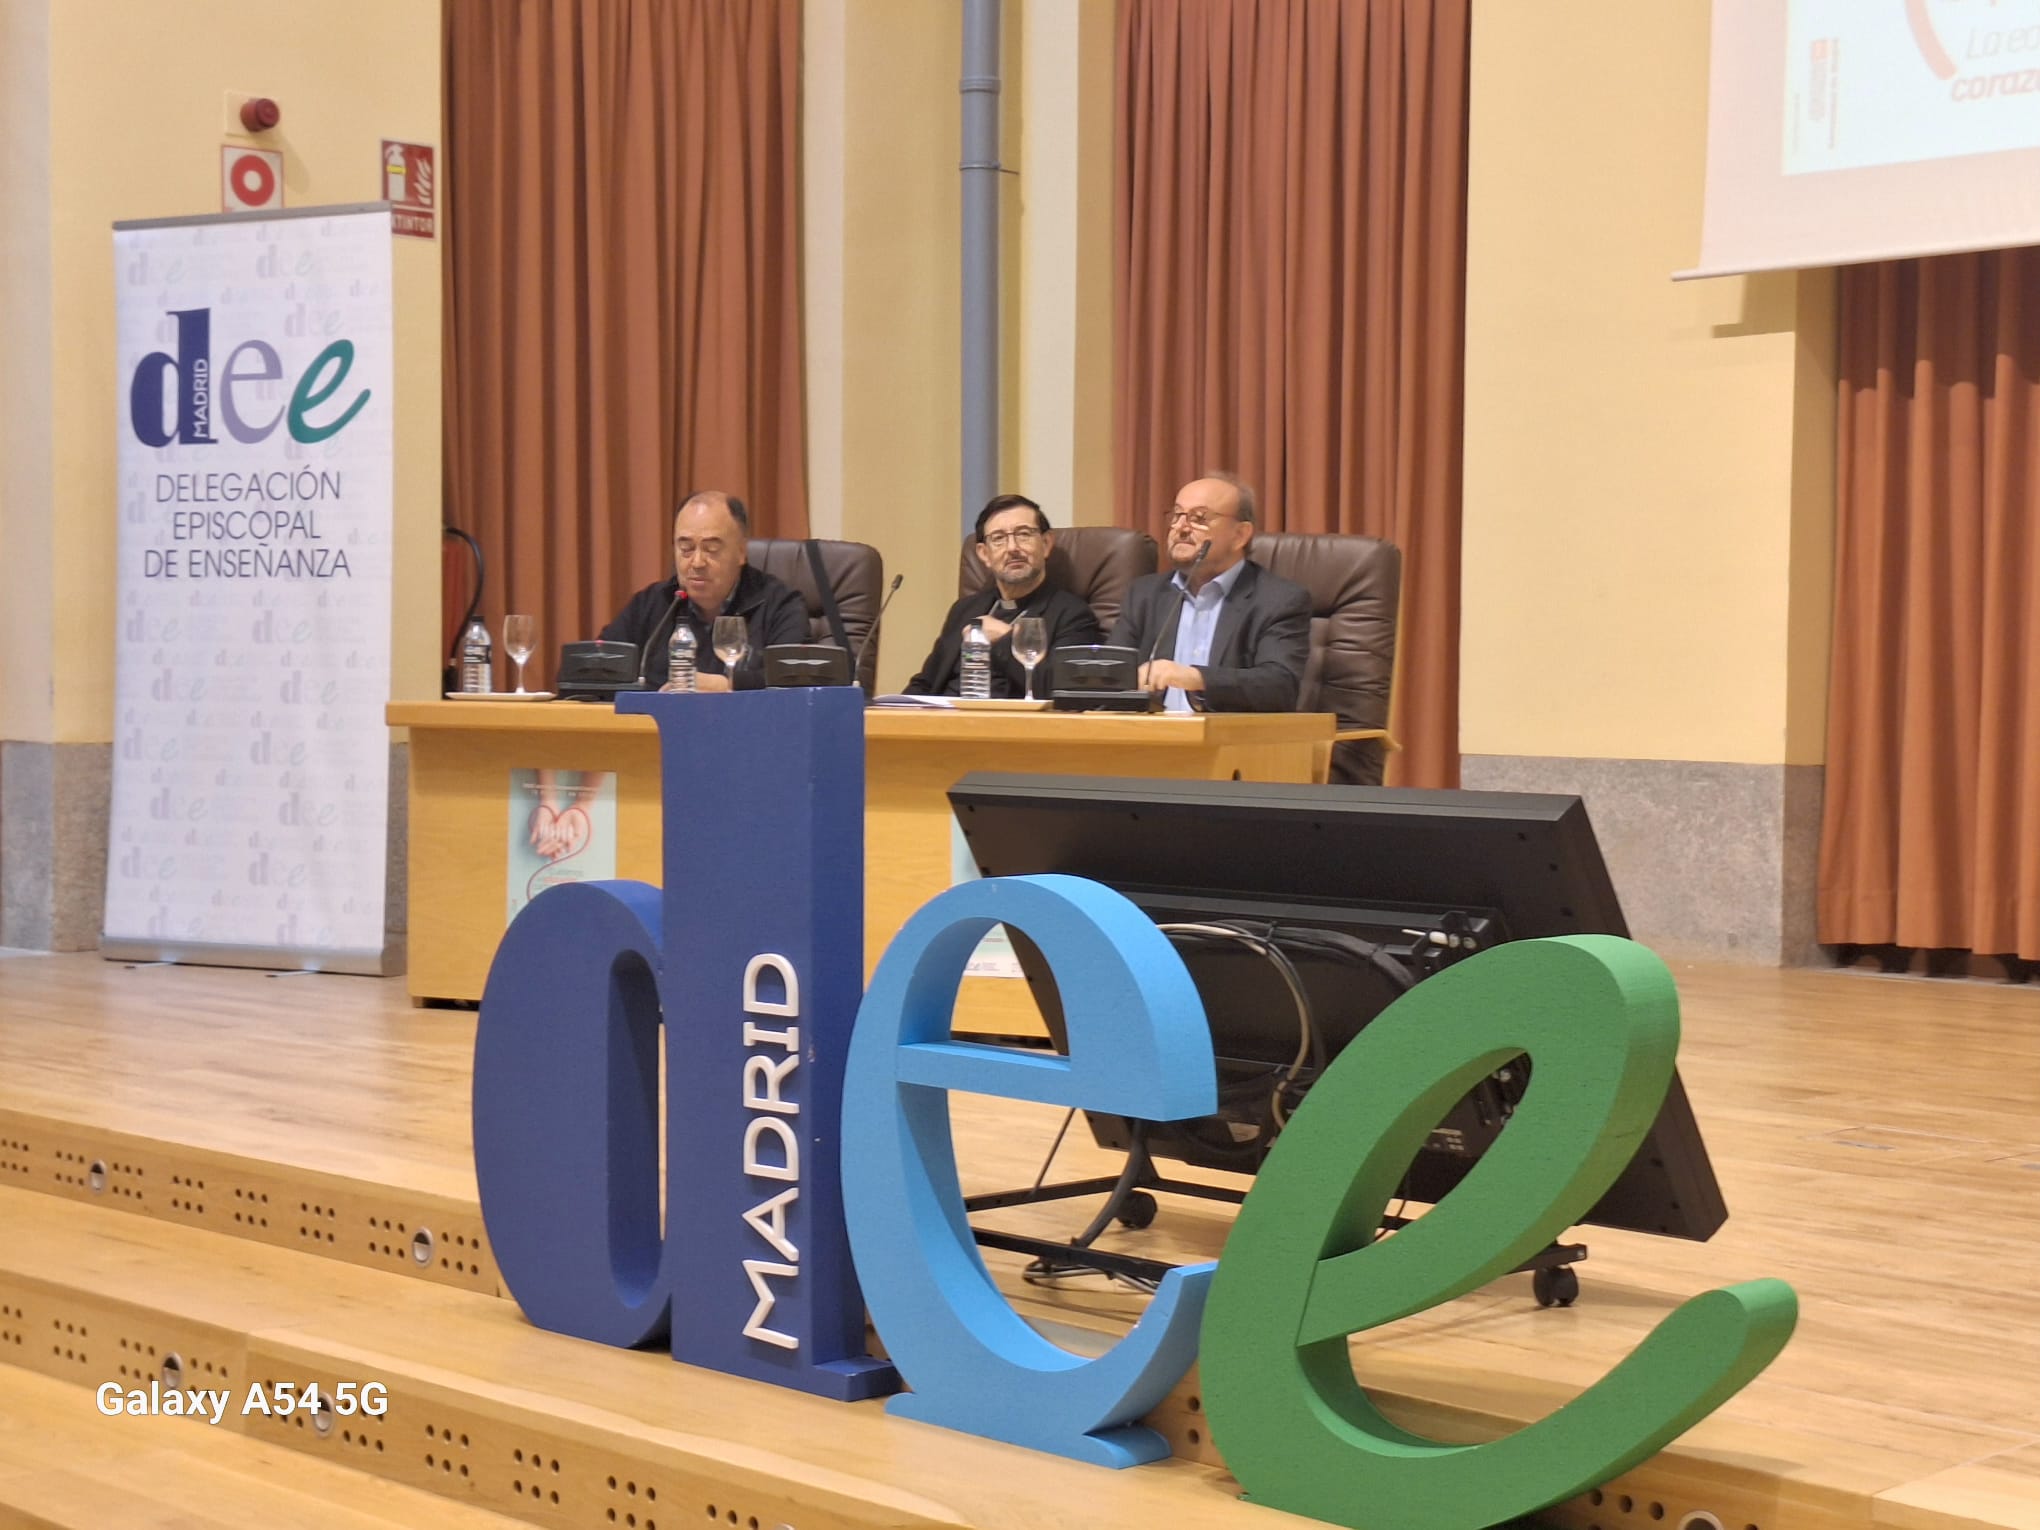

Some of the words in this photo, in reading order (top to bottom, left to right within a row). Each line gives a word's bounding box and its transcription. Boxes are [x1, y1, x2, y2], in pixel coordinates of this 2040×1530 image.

[193, 358, 209, 438] MADRID
[156, 464, 341, 502] DELEGACIÓN
[173, 510, 322, 540] EPISCOPAL
[144, 549, 178, 578] DE
[188, 543, 352, 578] ENSEÑANZA
[741, 952, 800, 1350] MADRID
